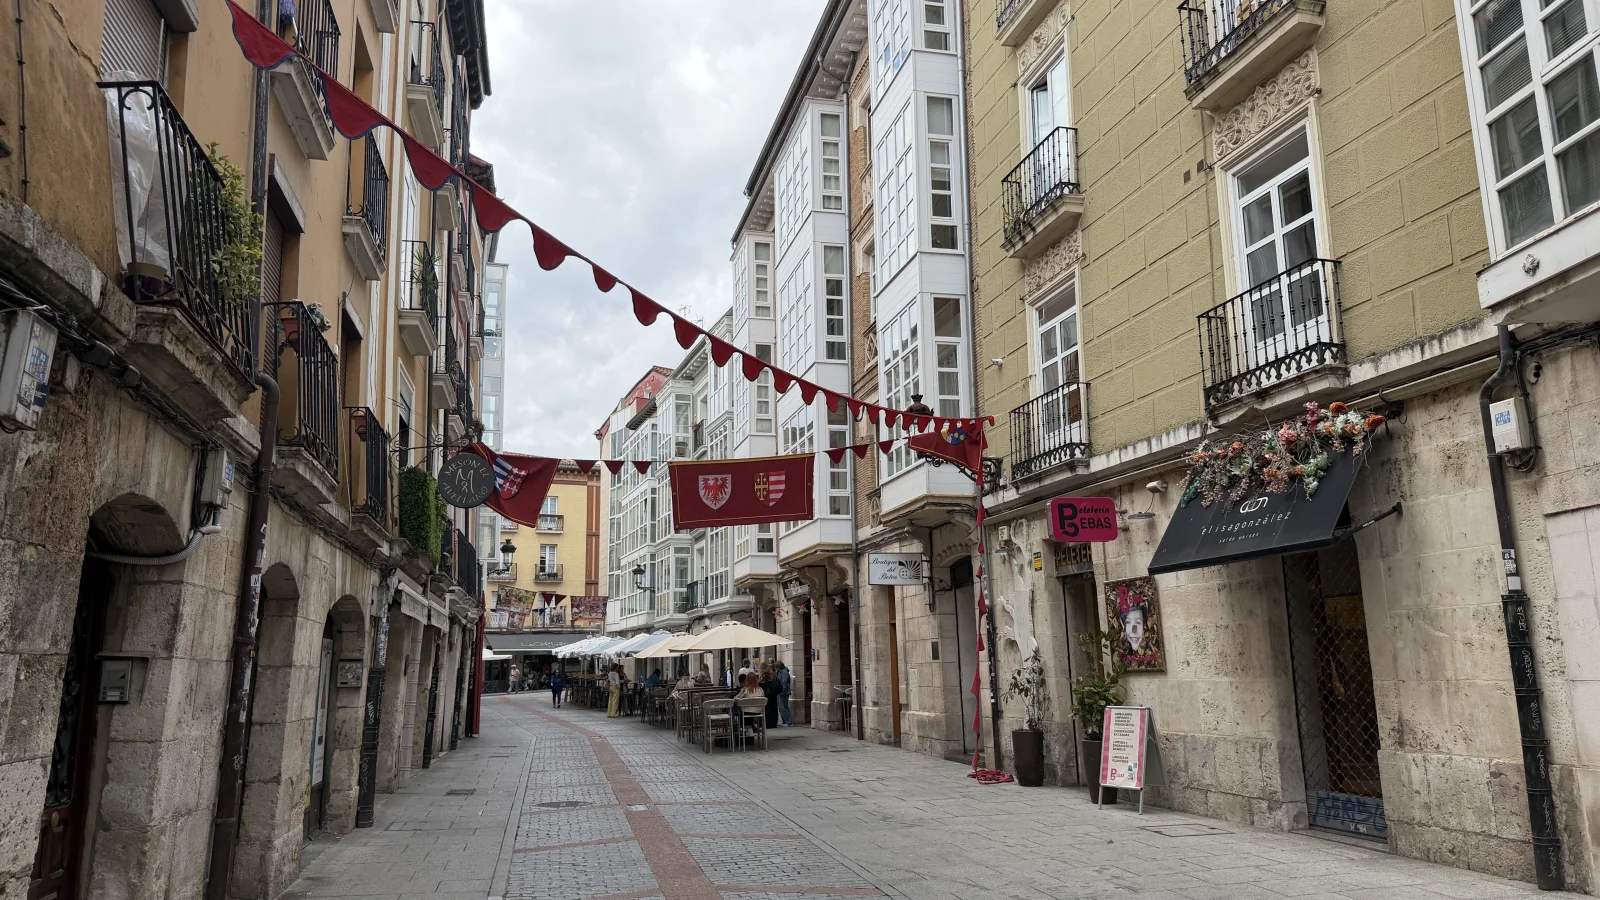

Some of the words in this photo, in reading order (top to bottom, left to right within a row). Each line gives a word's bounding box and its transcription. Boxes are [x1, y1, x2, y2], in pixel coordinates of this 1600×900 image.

[480, 468, 489, 478] EL
[443, 483, 488, 503] AVELLANO
[870, 558, 897, 566] Boutique
